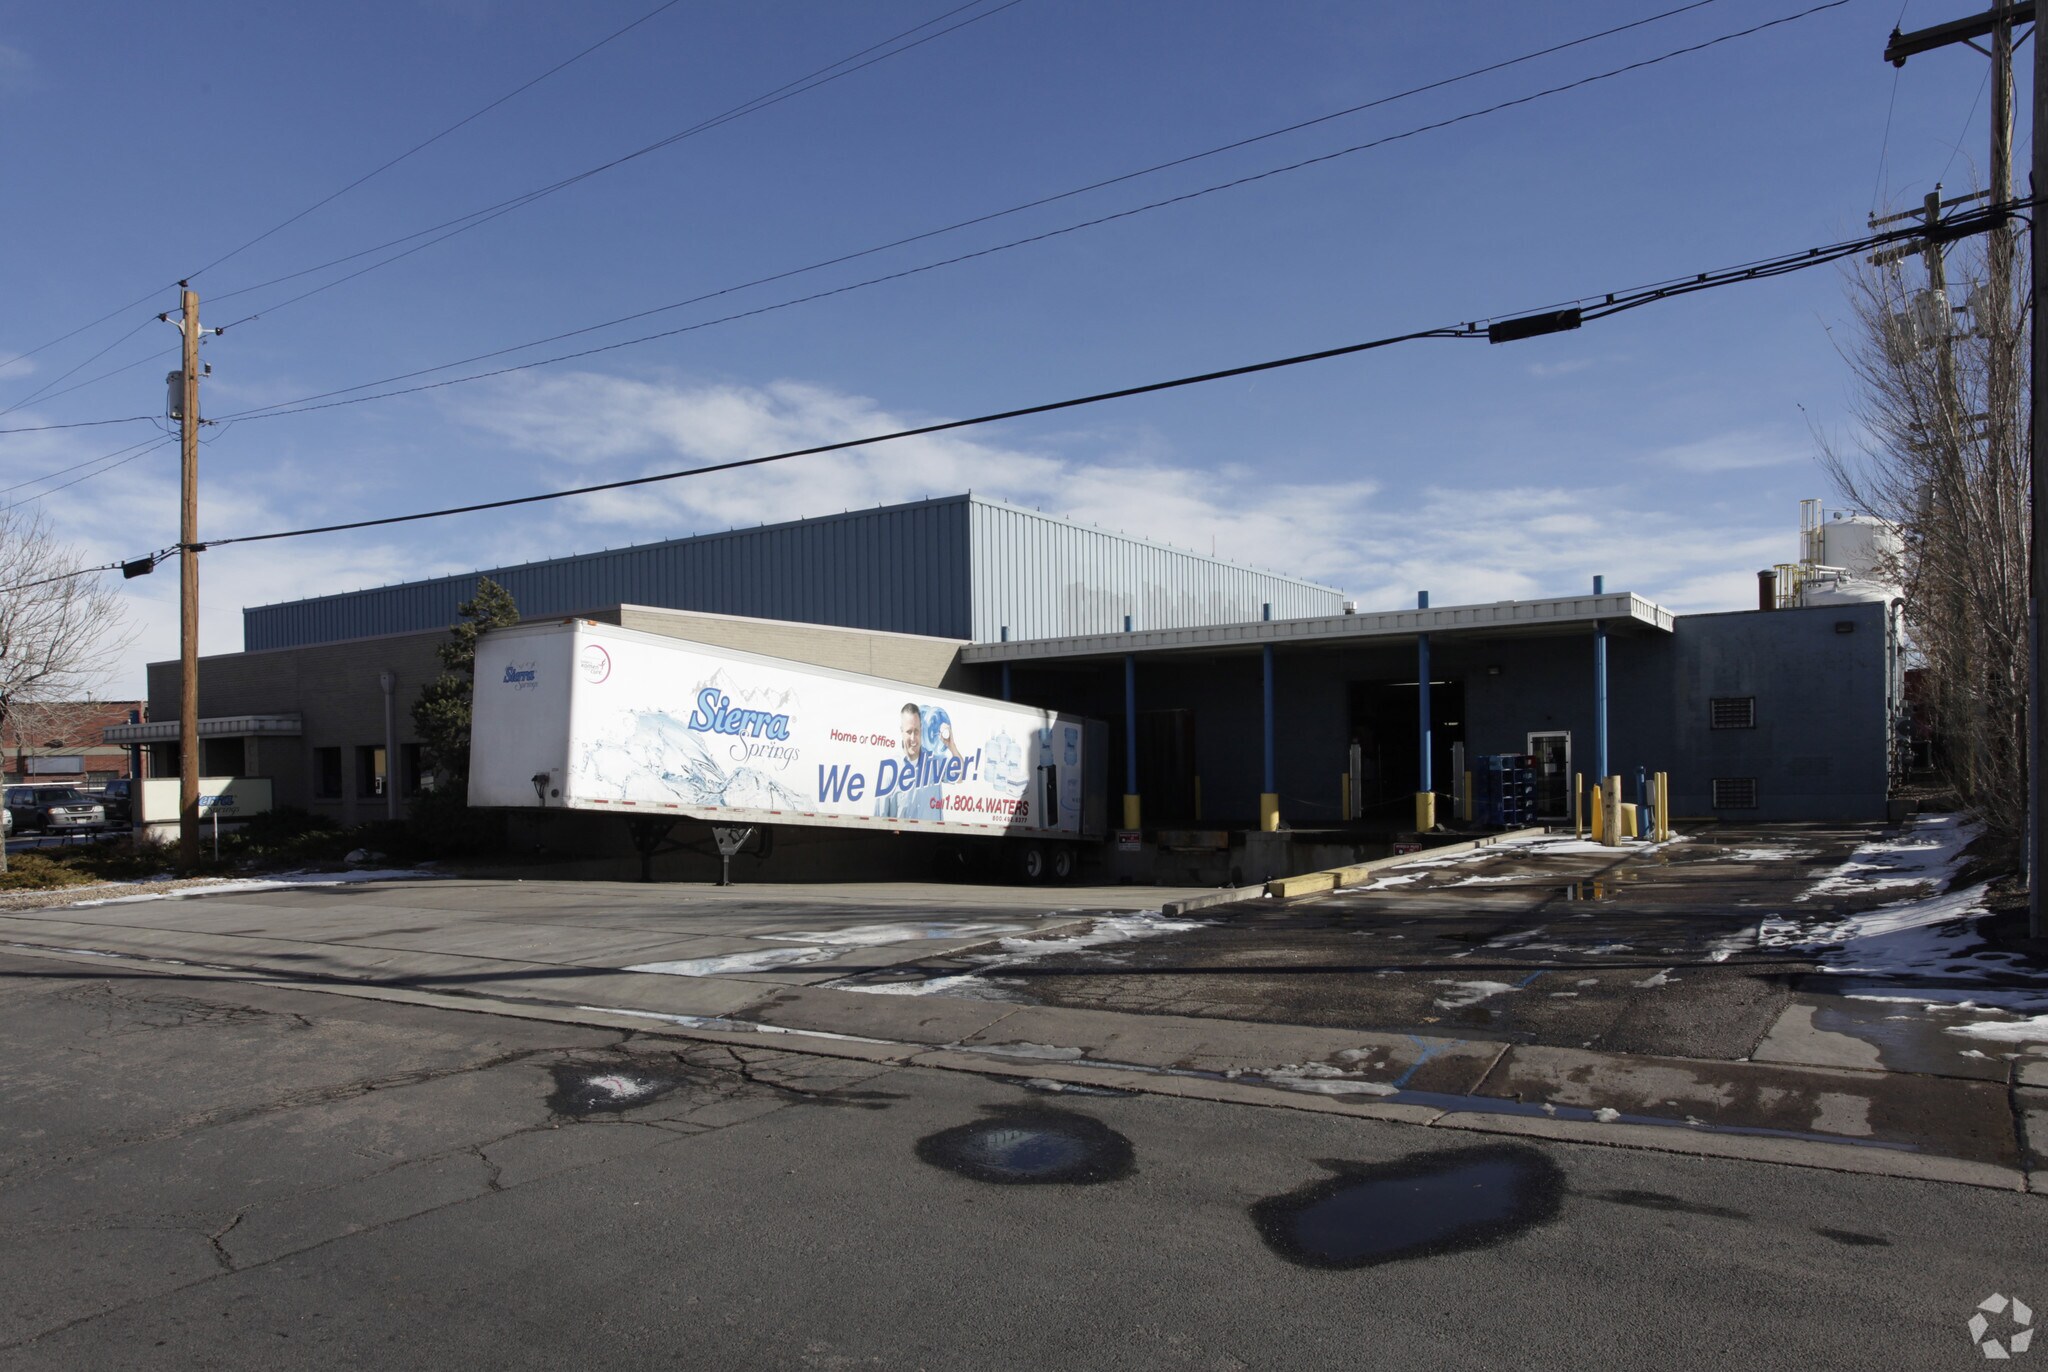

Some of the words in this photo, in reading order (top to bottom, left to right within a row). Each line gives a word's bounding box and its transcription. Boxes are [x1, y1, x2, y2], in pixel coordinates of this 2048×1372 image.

[503, 666, 536, 683] Sierra
[688, 687, 790, 741] Sierra
[729, 729, 800, 771] Springs
[830, 728, 857, 744] Home
[859, 734, 869, 745] or
[870, 733, 896, 749] Office
[818, 764, 865, 803] We
[874, 748, 981, 798] Deliver!
[929, 797, 945, 810] Call
